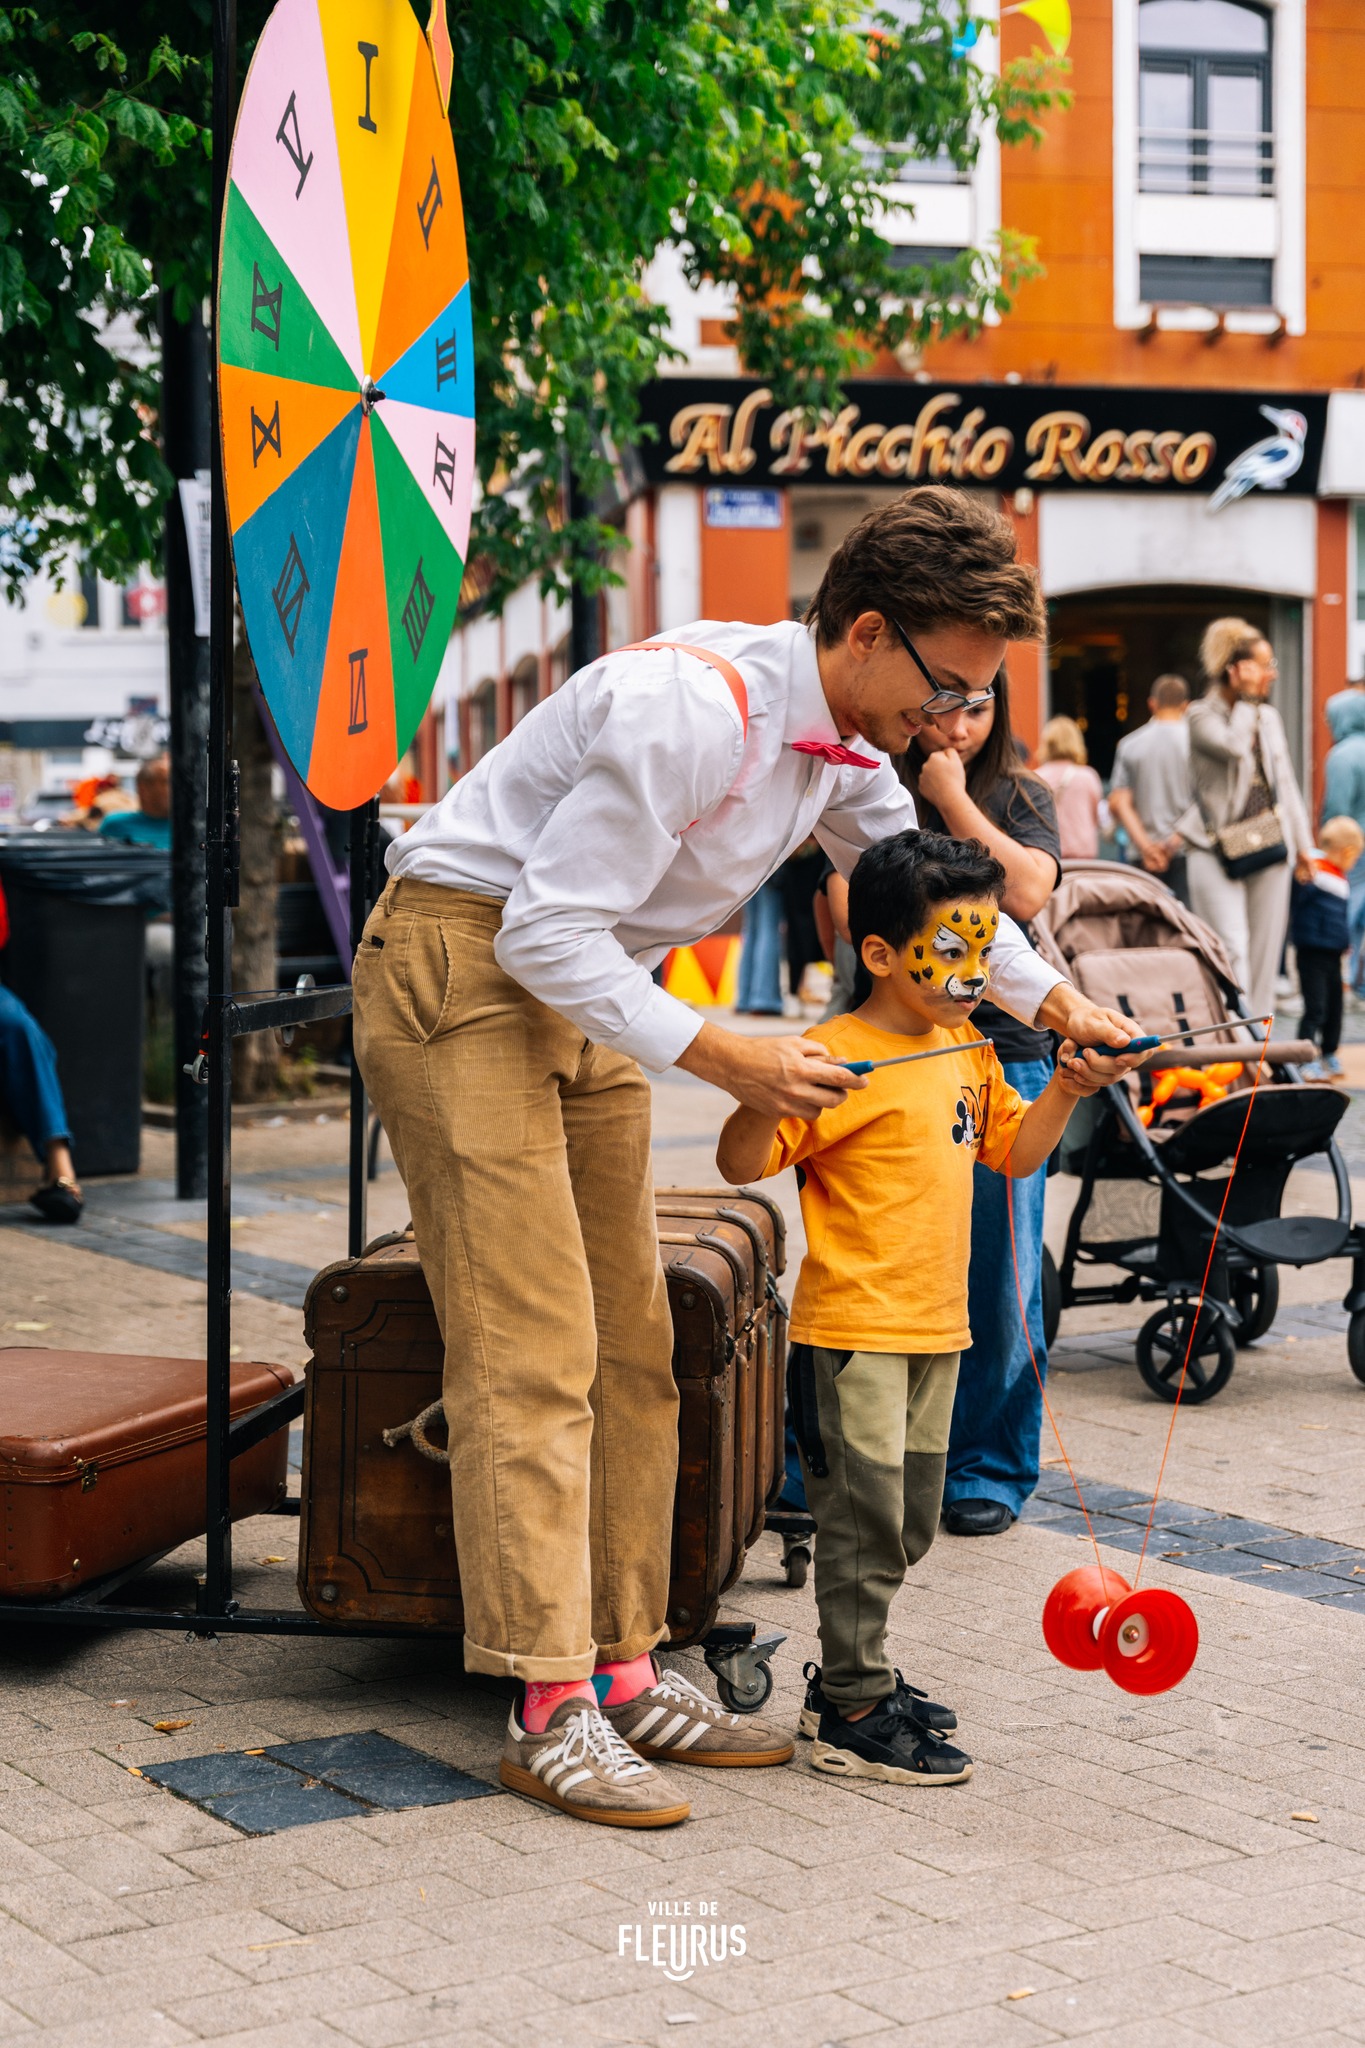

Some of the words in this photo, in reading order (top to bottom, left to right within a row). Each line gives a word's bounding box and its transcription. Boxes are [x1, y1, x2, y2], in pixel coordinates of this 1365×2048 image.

[357, 41, 379, 134] I
[275, 90, 314, 200] V
[416, 155, 443, 252] II
[251, 260, 283, 352] IX
[436, 328, 457, 392] III
[250, 400, 282, 468] X
[433, 432, 456, 505] IV
[664, 388, 773, 475] Al
[769, 391, 1015, 480] Picchio
[1023, 410, 1217, 484] Rosso
[271, 531, 311, 658] VII
